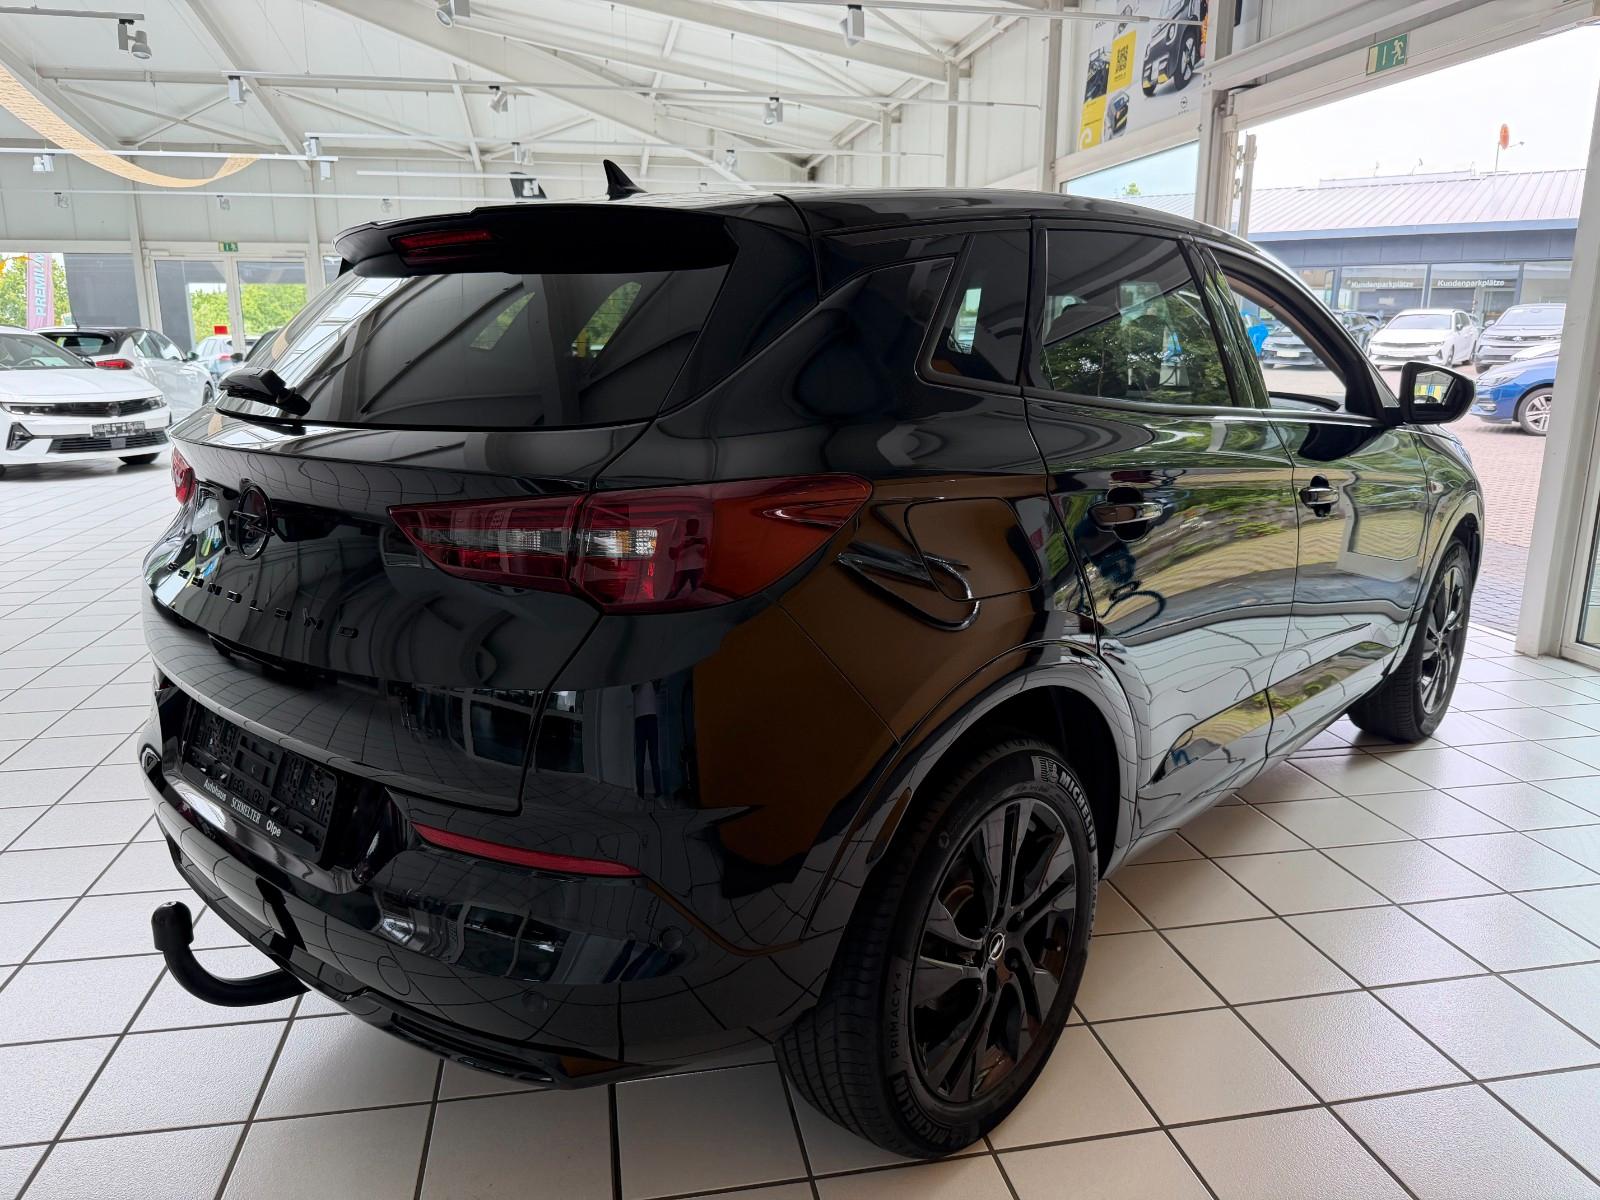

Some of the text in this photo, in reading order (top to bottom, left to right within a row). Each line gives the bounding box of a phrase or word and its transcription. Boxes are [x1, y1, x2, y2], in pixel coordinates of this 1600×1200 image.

[203, 779, 227, 802] Autohaus
[266, 819, 282, 837] Olpe
[1059, 772, 1096, 847] MICHELIN
[890, 984, 902, 1058] PRIMACY
[893, 1075, 952, 1144] MICHELIN
